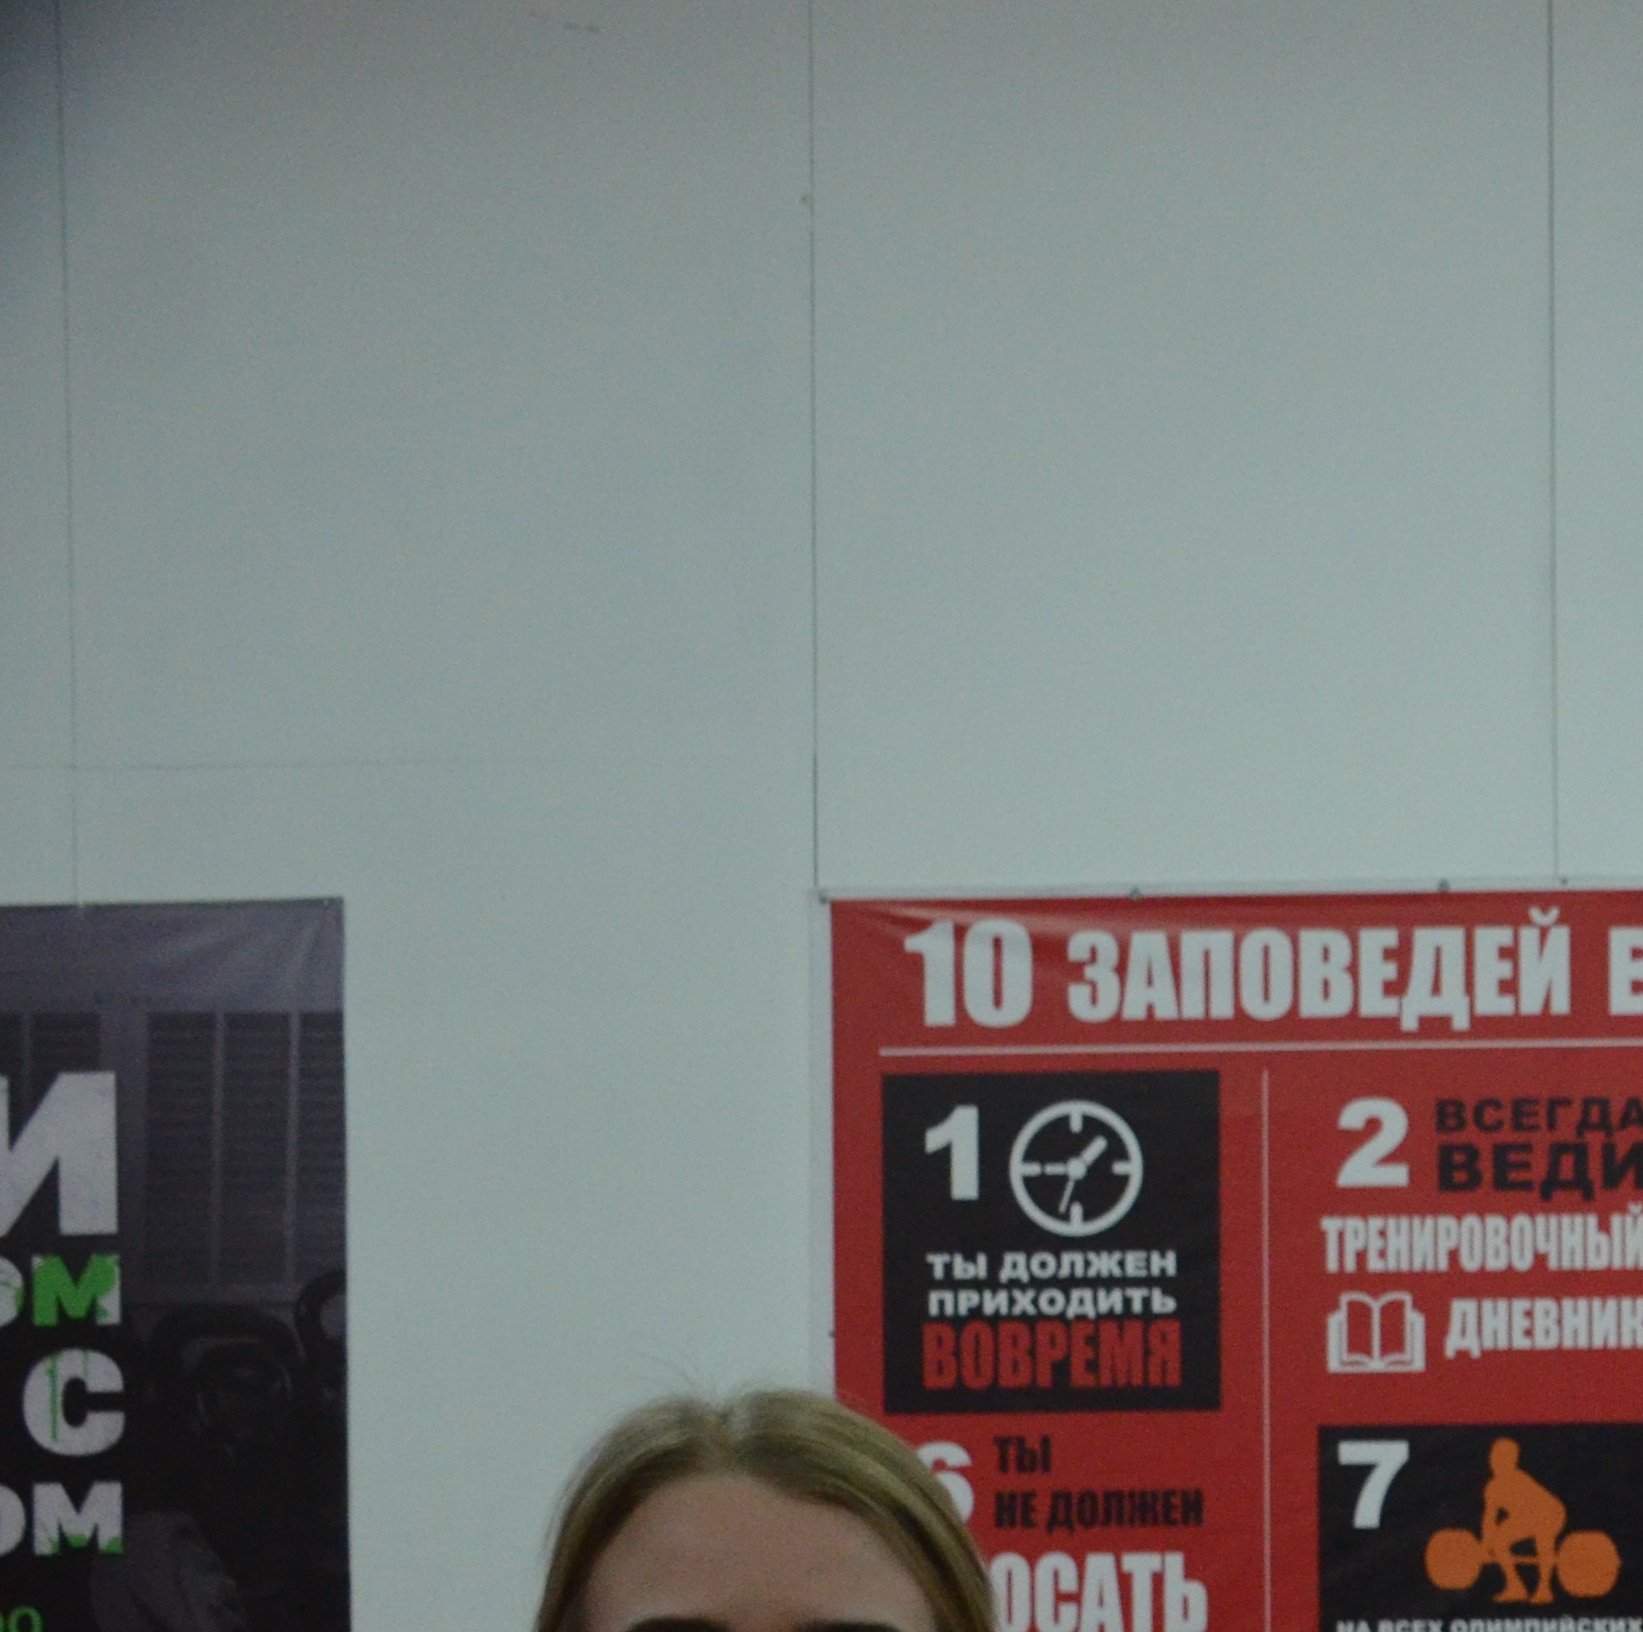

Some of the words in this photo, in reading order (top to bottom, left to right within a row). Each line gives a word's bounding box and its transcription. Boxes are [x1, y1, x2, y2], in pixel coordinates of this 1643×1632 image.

[903, 916, 1033, 1029] 10
[1067, 906, 1571, 1032] ЗАПОВЕДЕЙ
[923, 1104, 981, 1202] 1
[1336, 1097, 1410, 1190] 2
[926, 1252, 989, 1282] ТЫ
[999, 1249, 1179, 1285] ДОЛЖЕН
[927, 1286, 1179, 1322] ПРИХОДИТЬ
[922, 1318, 1183, 1392] ВОВРЕМЯ
[995, 1435, 1052, 1474] ТЫ
[1336, 1439, 1410, 1530] 7
[995, 1490, 1041, 1526] НЕ
[1050, 1487, 1206, 1530] ДОЛЖЕН
